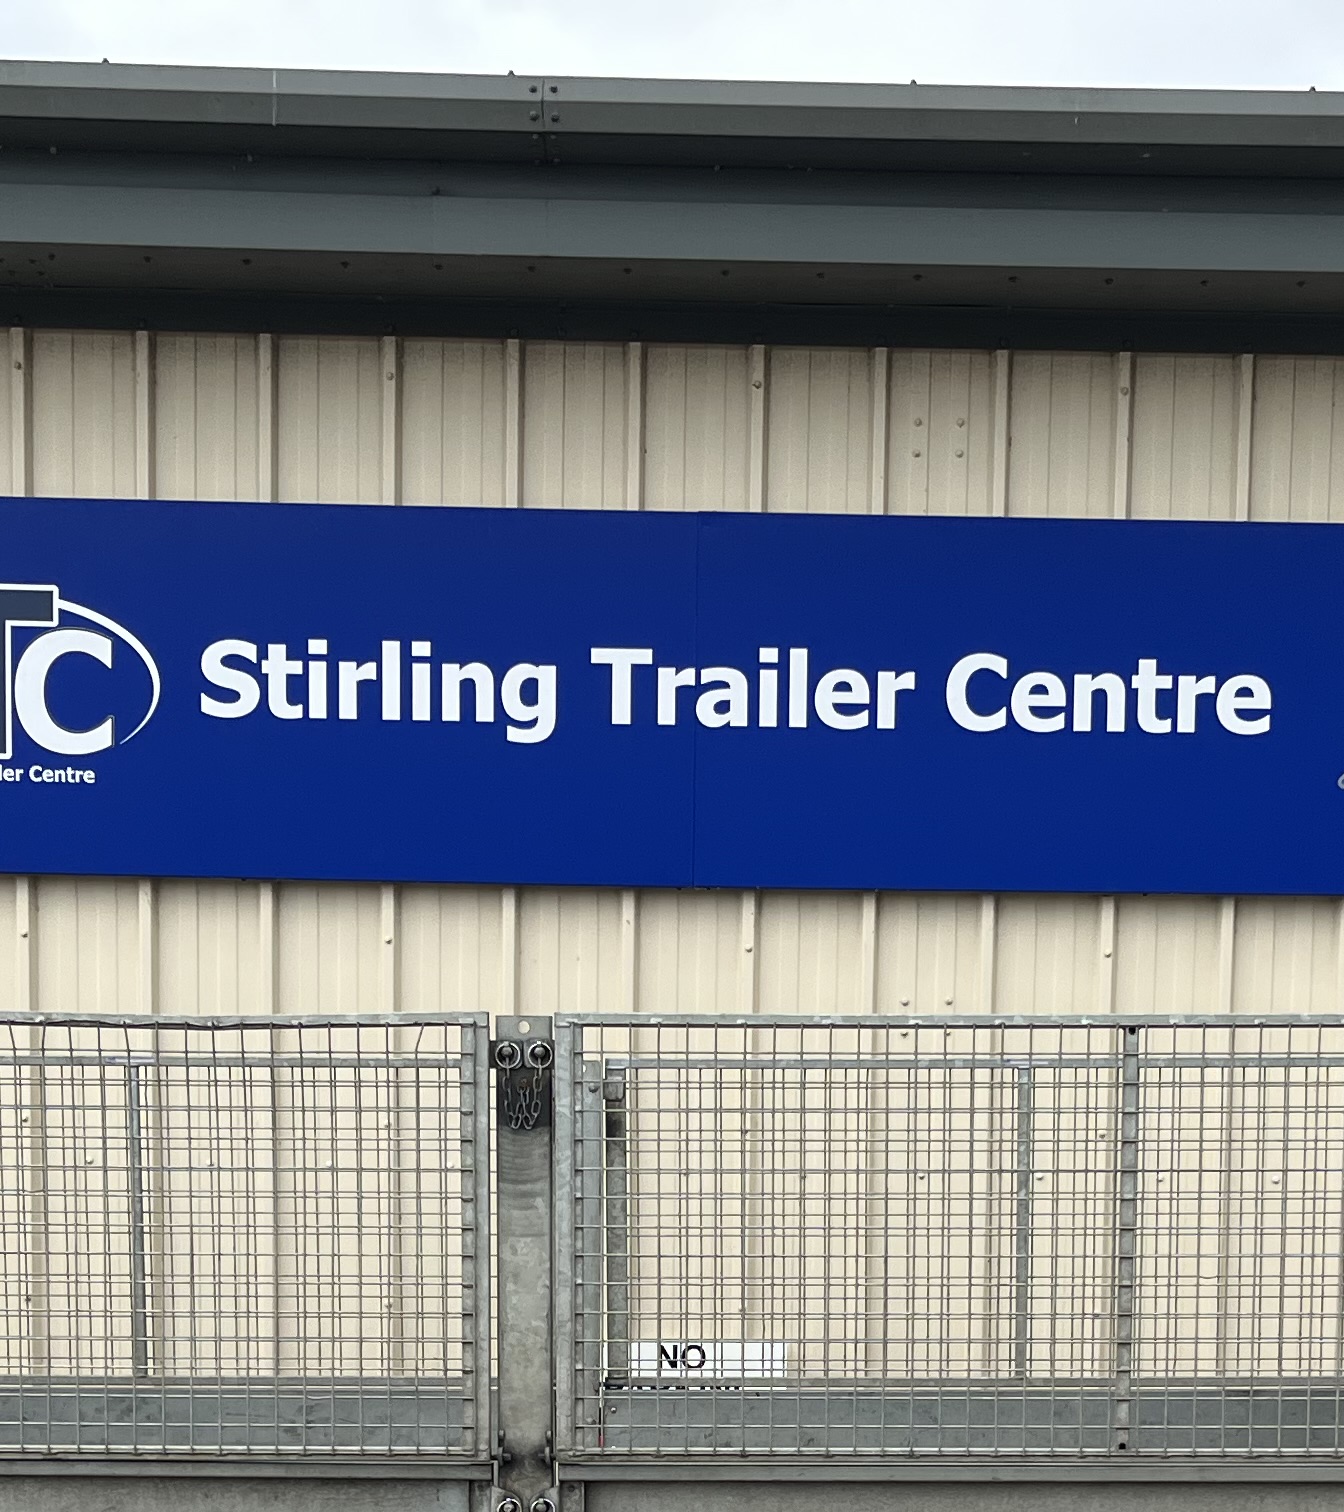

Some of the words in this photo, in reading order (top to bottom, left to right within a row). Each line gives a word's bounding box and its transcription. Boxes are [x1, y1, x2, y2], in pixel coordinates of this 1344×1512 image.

[201, 639, 556, 743] Stirling
[591, 648, 915, 729] Trailer
[946, 653, 1271, 735] Centre
[28, 765, 96, 784] Centre
[659, 1344, 706, 1370] NO
